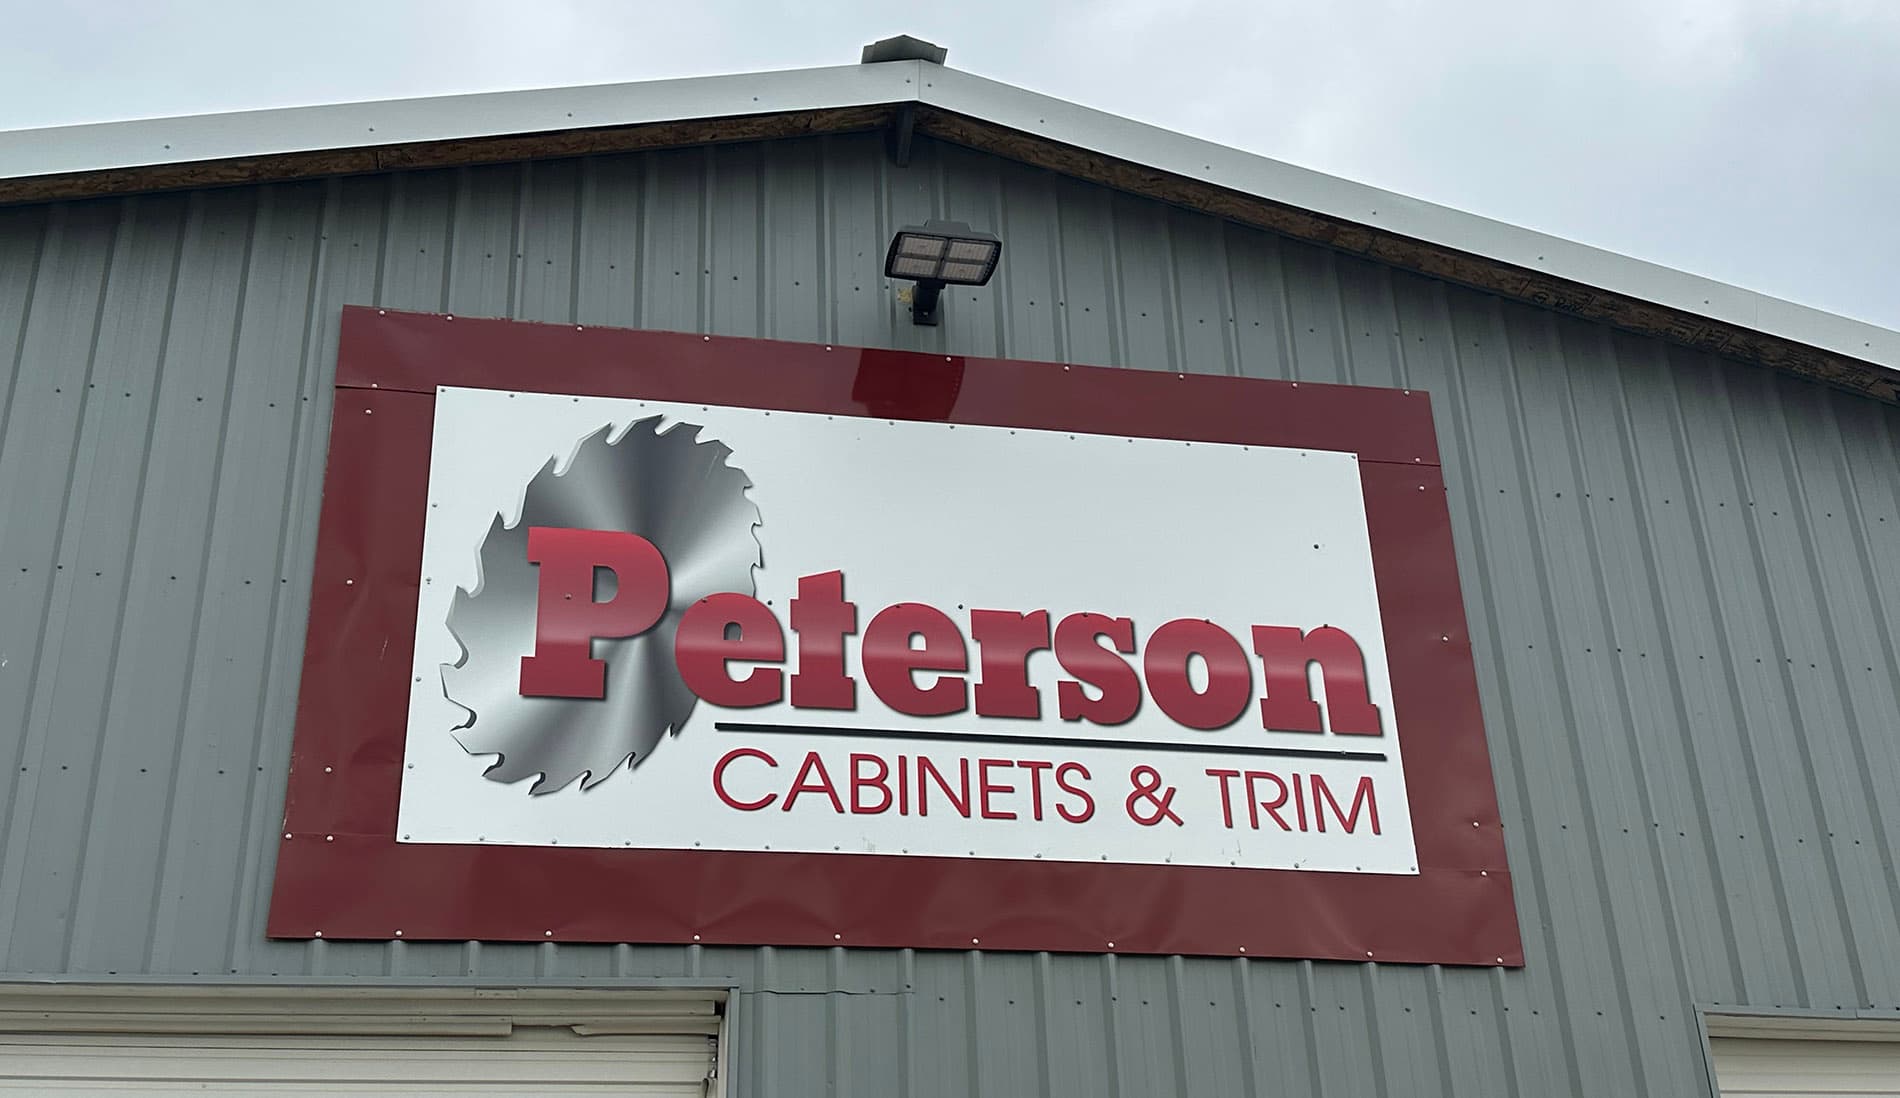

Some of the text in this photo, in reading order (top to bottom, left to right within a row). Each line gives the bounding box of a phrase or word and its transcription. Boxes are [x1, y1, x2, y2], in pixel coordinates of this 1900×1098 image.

[519, 526, 1382, 736] Peterson
[713, 748, 1381, 836] CABINETS & TRIM
